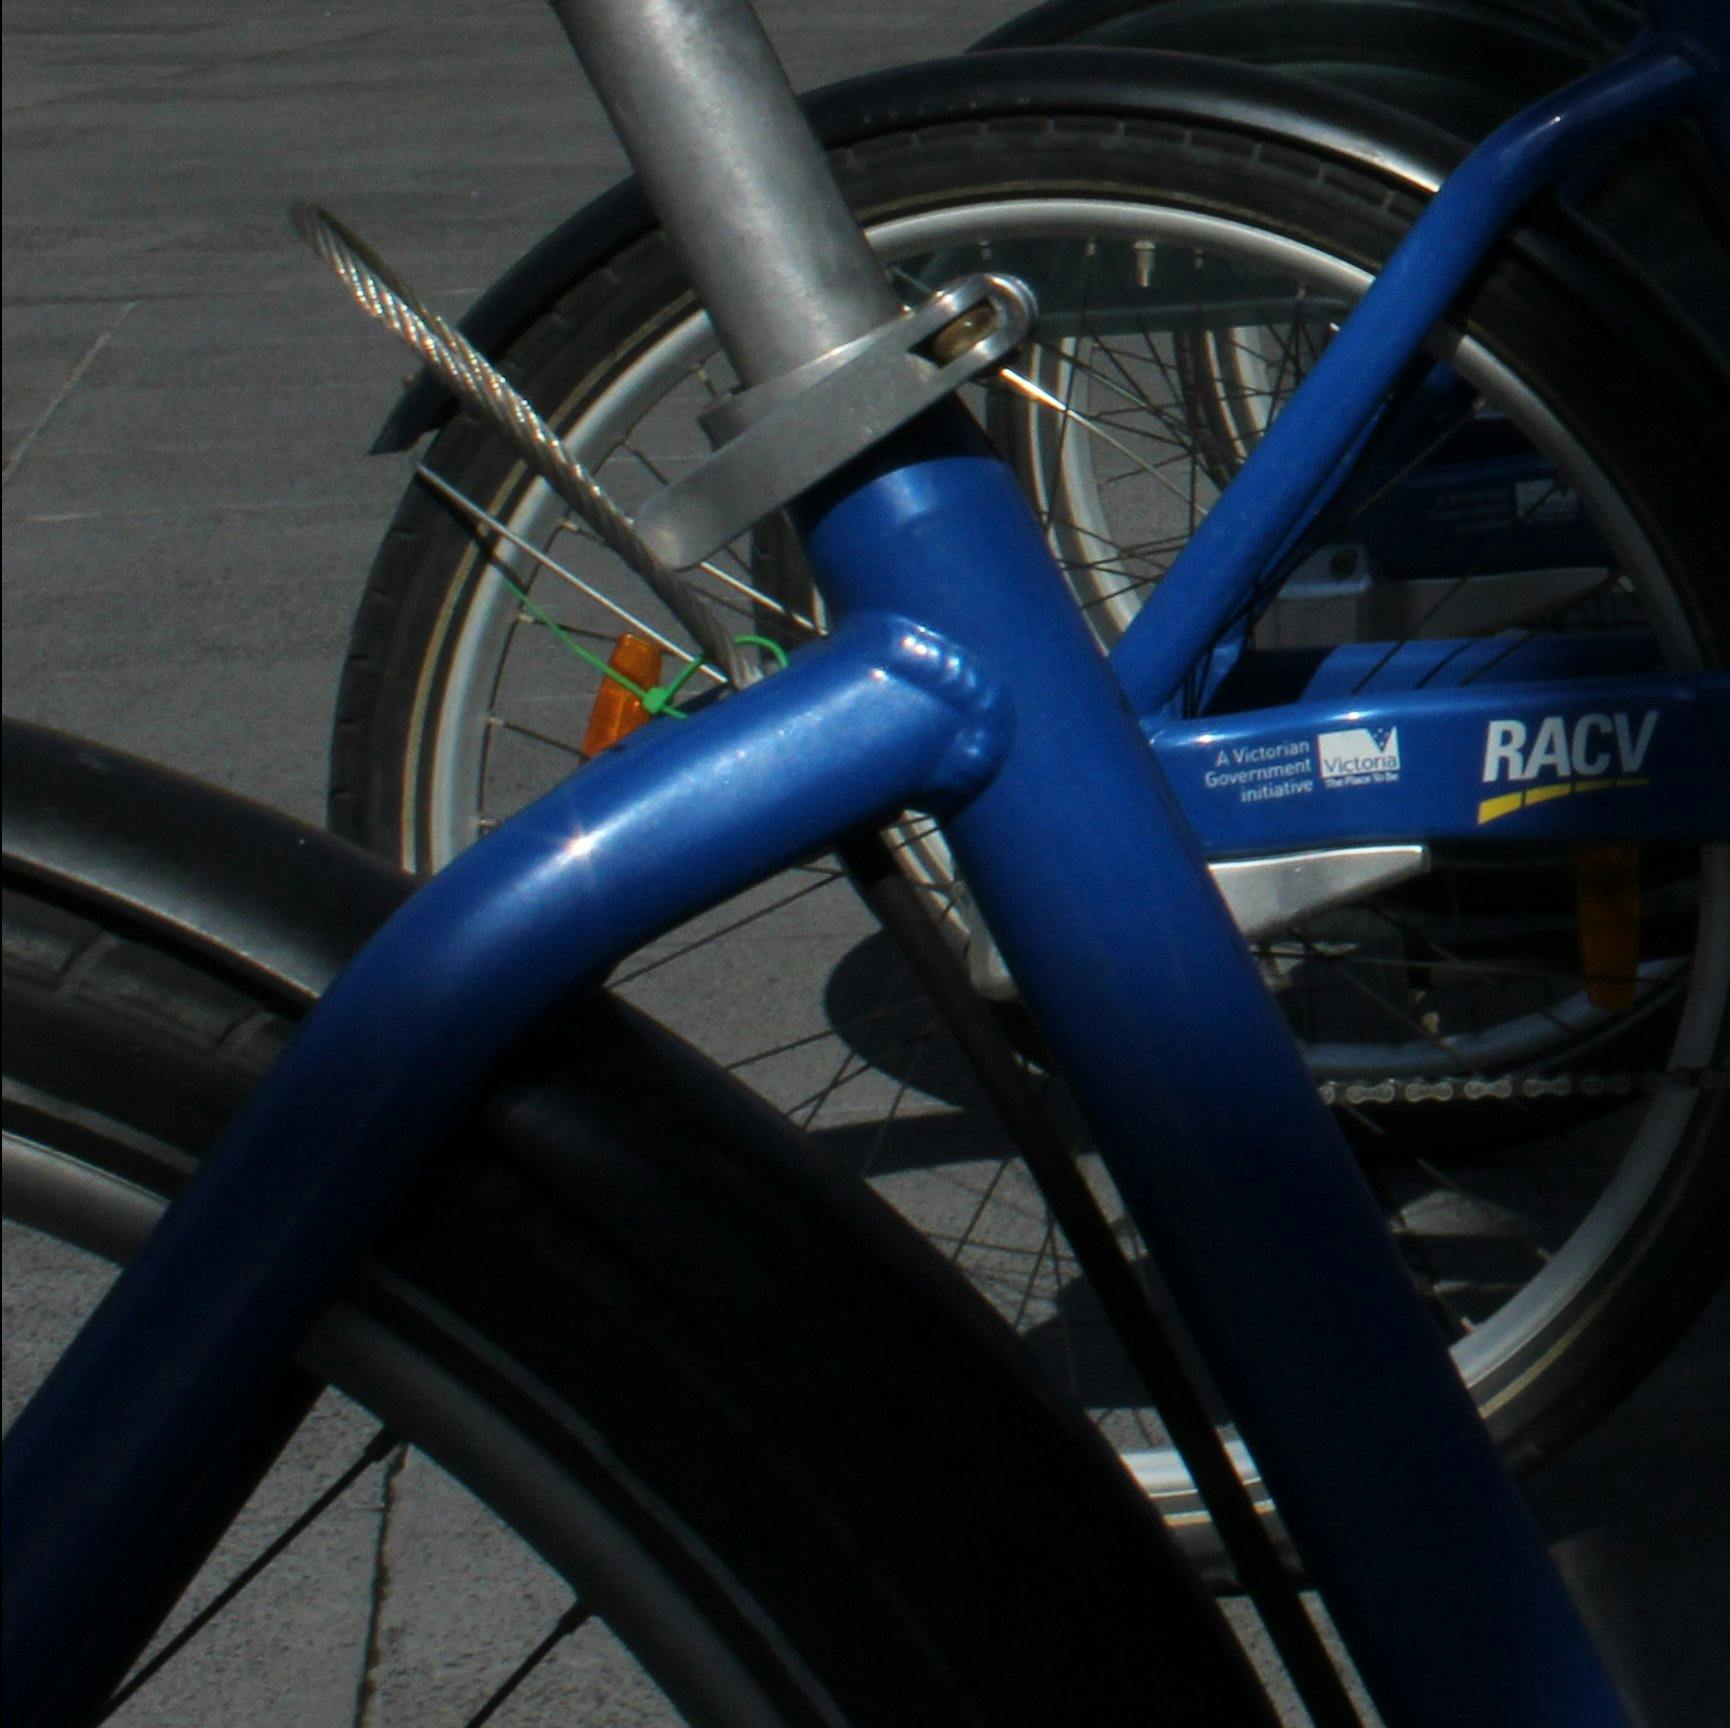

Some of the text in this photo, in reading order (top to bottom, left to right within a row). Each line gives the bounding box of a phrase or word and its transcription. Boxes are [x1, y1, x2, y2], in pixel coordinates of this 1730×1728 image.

[1215, 740, 1311, 768] A Victorian
[1481, 709, 1660, 784] RACV
[1204, 758, 1312, 789] Government
[1323, 753, 1398, 774] Victoria
[1240, 776, 1314, 803] initiative
